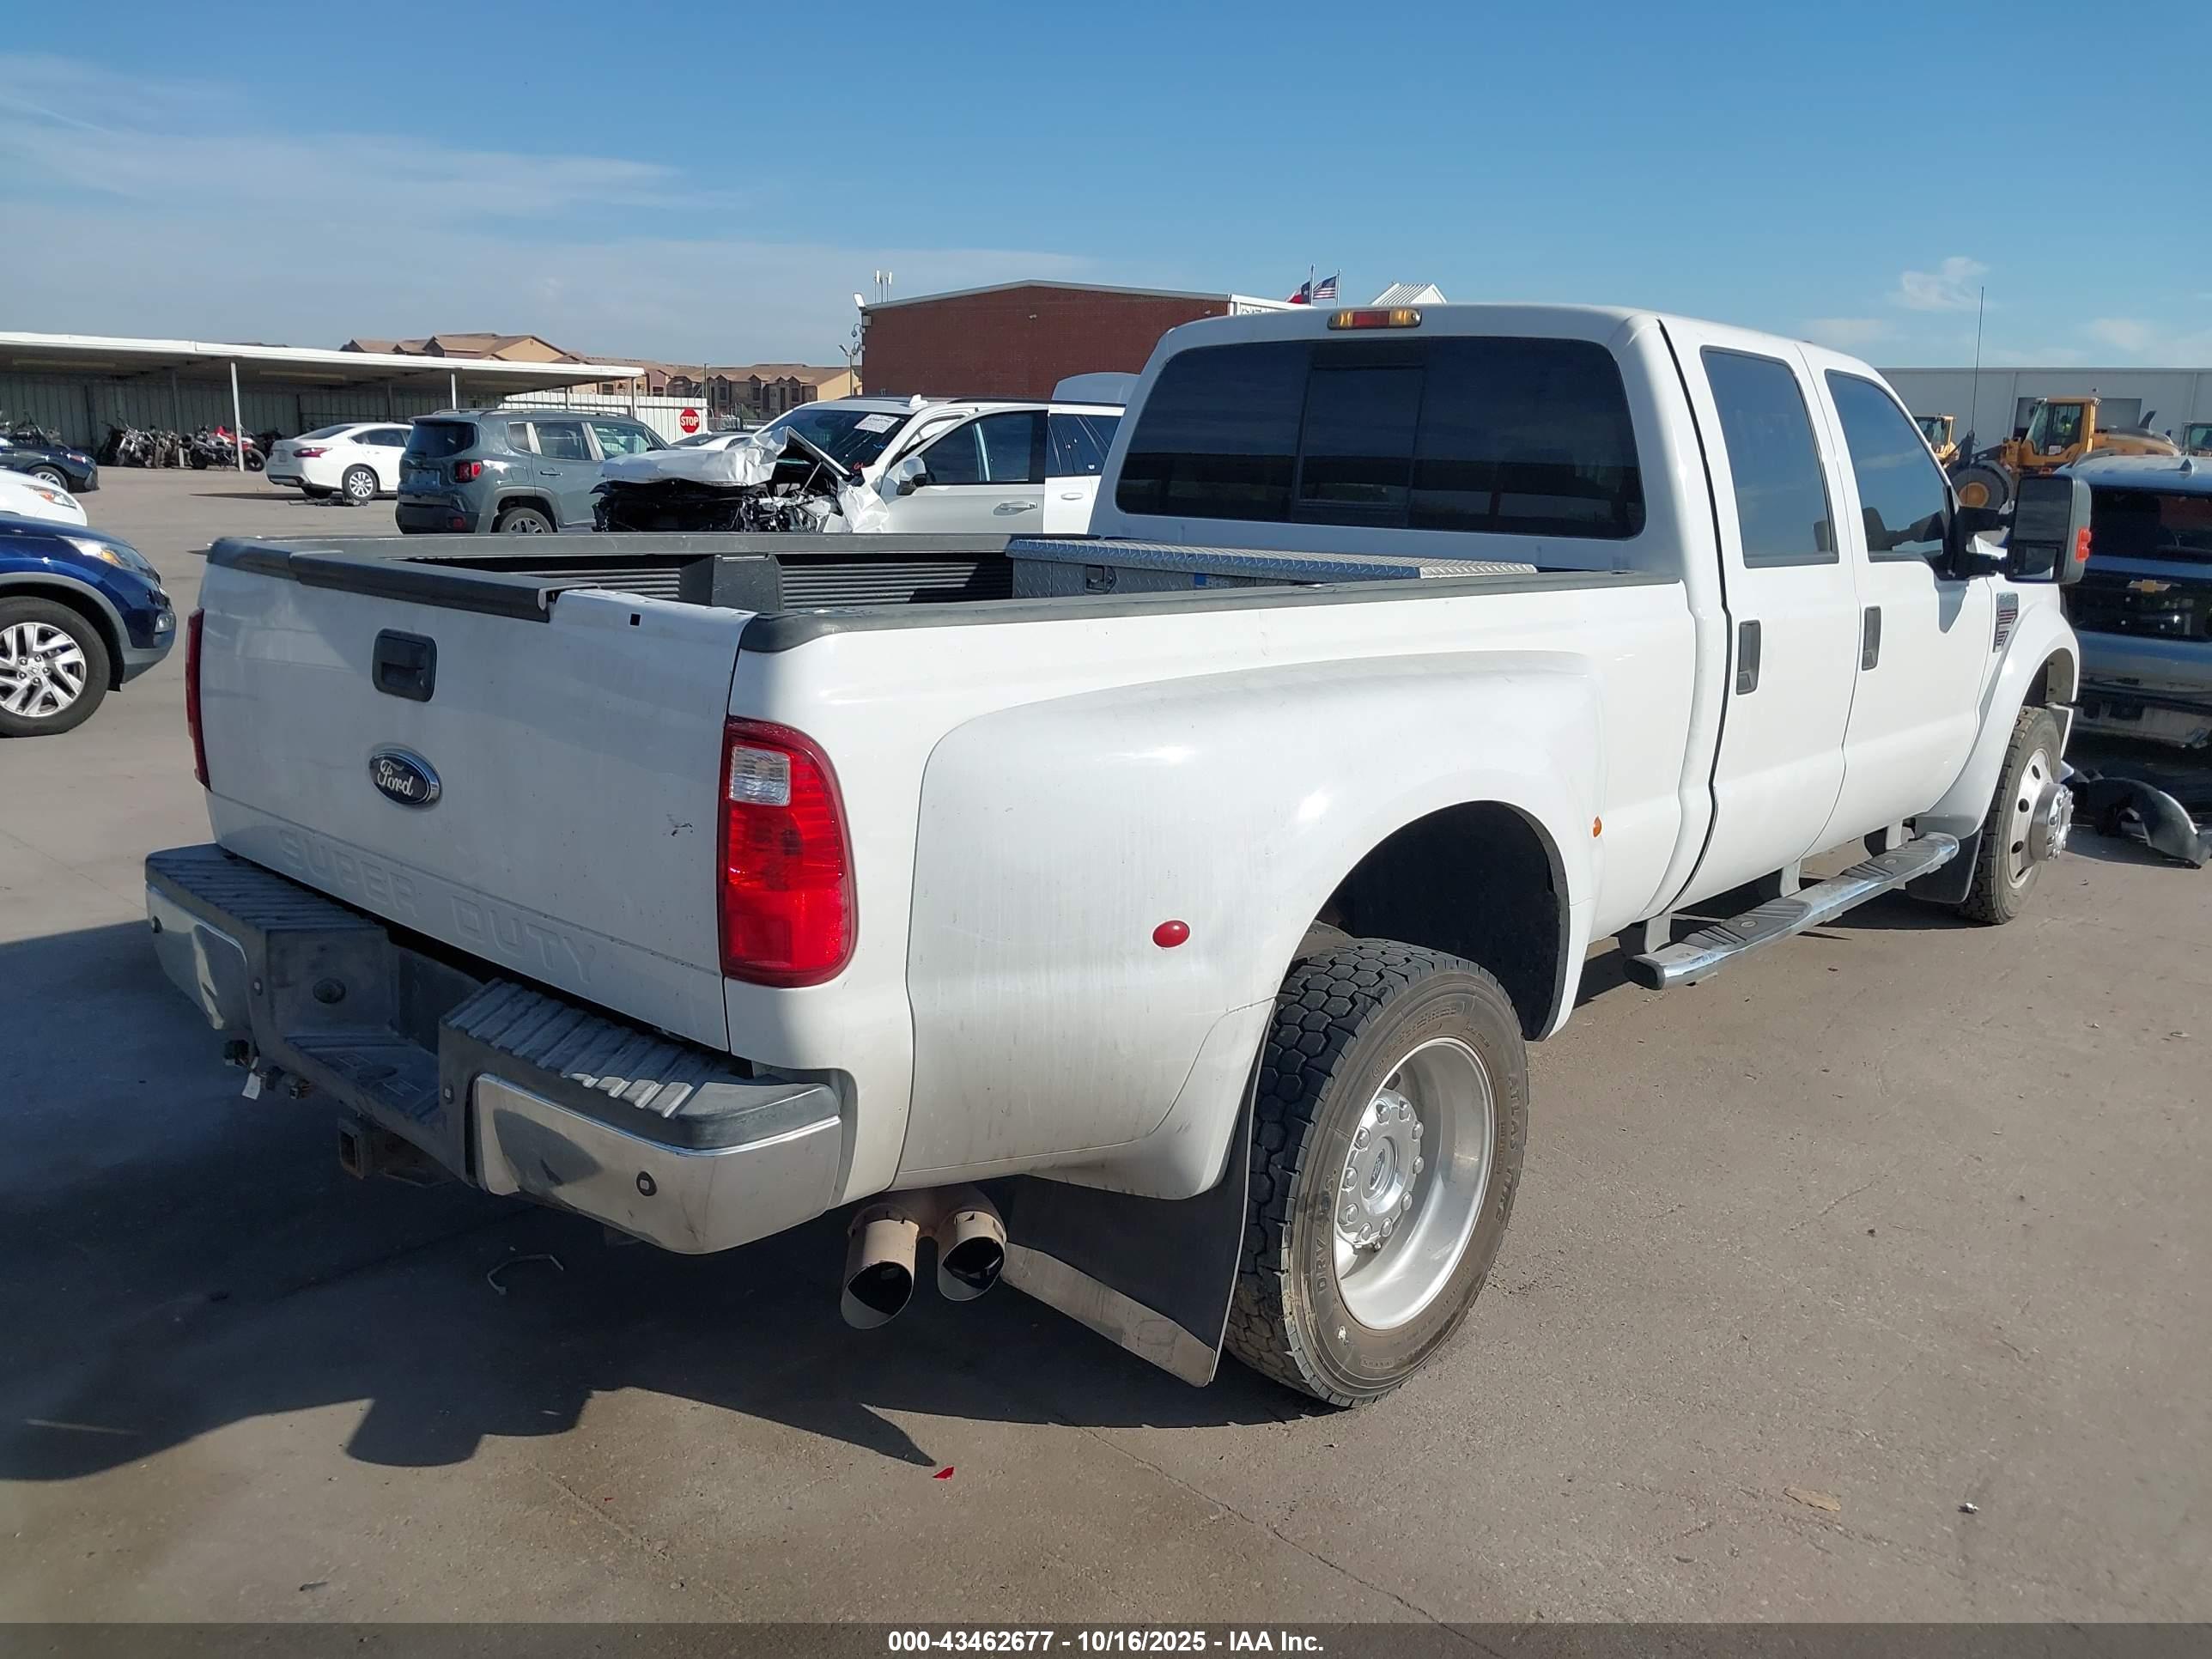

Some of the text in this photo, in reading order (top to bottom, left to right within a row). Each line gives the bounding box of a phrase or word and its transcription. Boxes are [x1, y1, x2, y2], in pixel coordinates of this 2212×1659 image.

[681, 416, 699, 427] STOP
[377, 759, 414, 797] Ford
[279, 830, 597, 985] SUPER DUTY
[1508, 1075, 1521, 1152] ATLAS
